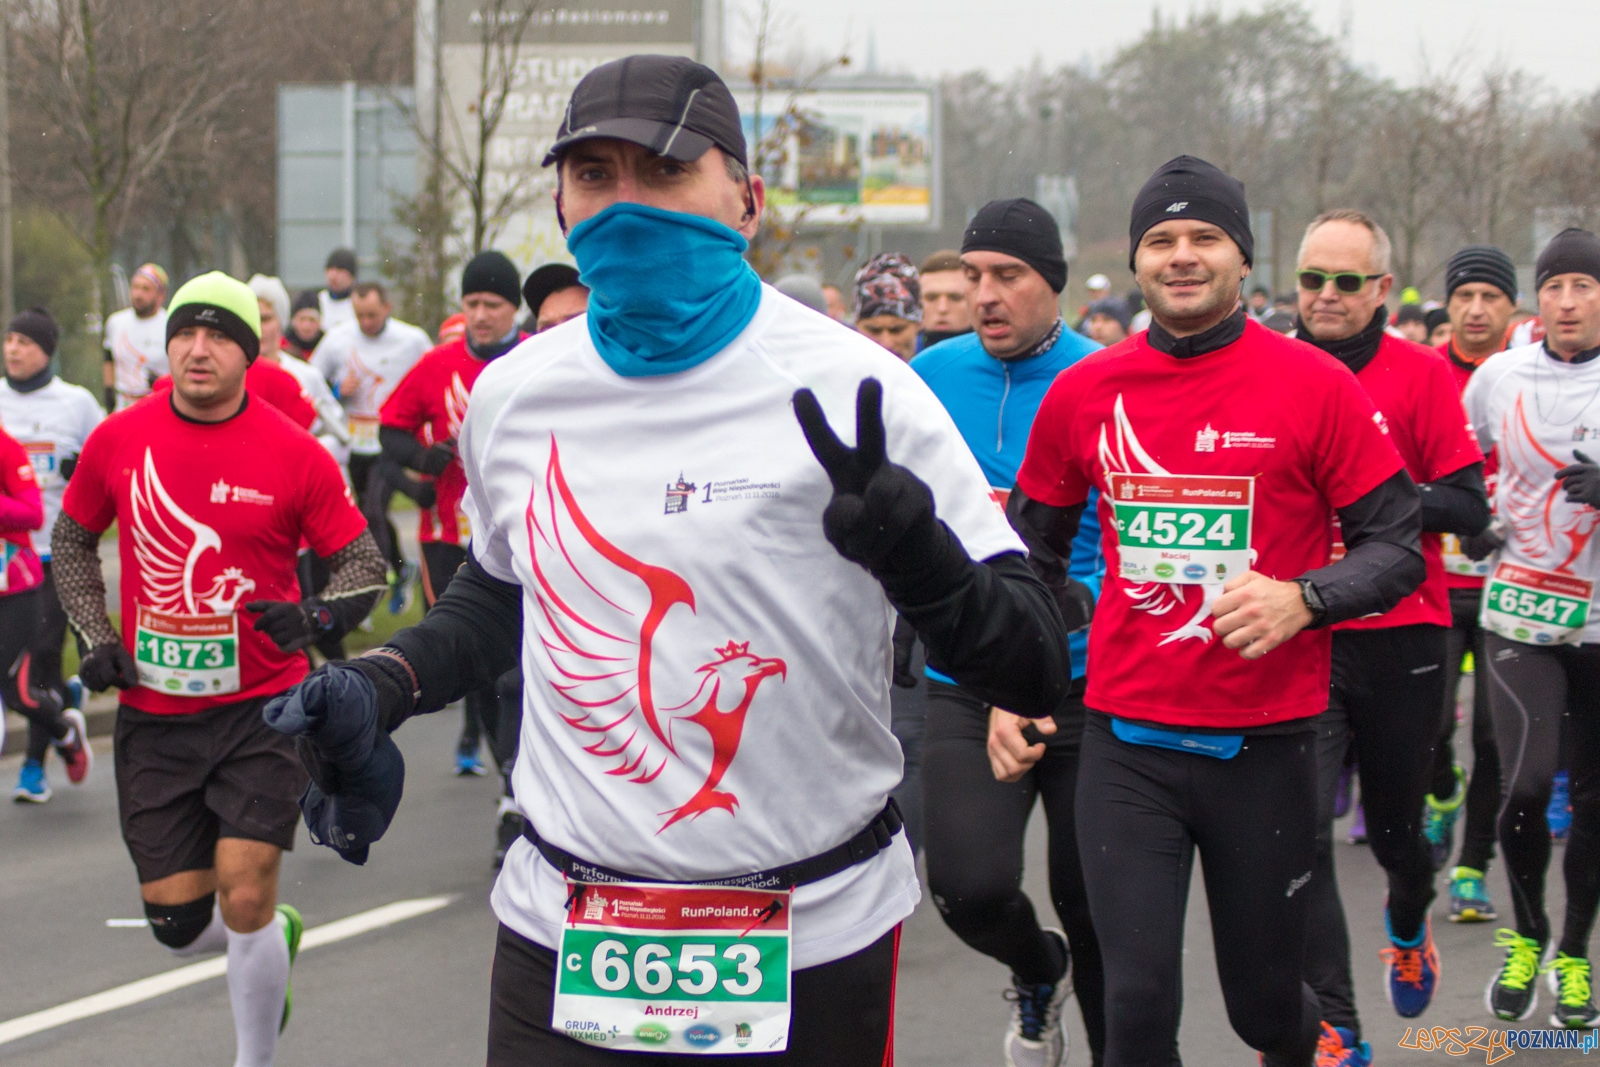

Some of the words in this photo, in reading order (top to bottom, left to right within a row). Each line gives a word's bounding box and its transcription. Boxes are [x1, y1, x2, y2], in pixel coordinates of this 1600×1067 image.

[702, 482, 713, 503] 1
[1182, 488, 1242, 499] RunPoland.org
[1128, 511, 1235, 546] 4524
[1161, 552, 1191, 561] Maciej
[1499, 587, 1578, 625] 6547
[147, 637, 225, 668] 1873
[572, 862, 629, 883] perform
[611, 899, 620, 917] 1
[681, 906, 764, 917] RunPoland.o
[566, 953, 582, 972] C
[590, 939, 764, 996] 6653
[644, 1005, 699, 1019] Andrzej
[565, 1020, 600, 1031] GRUPA
